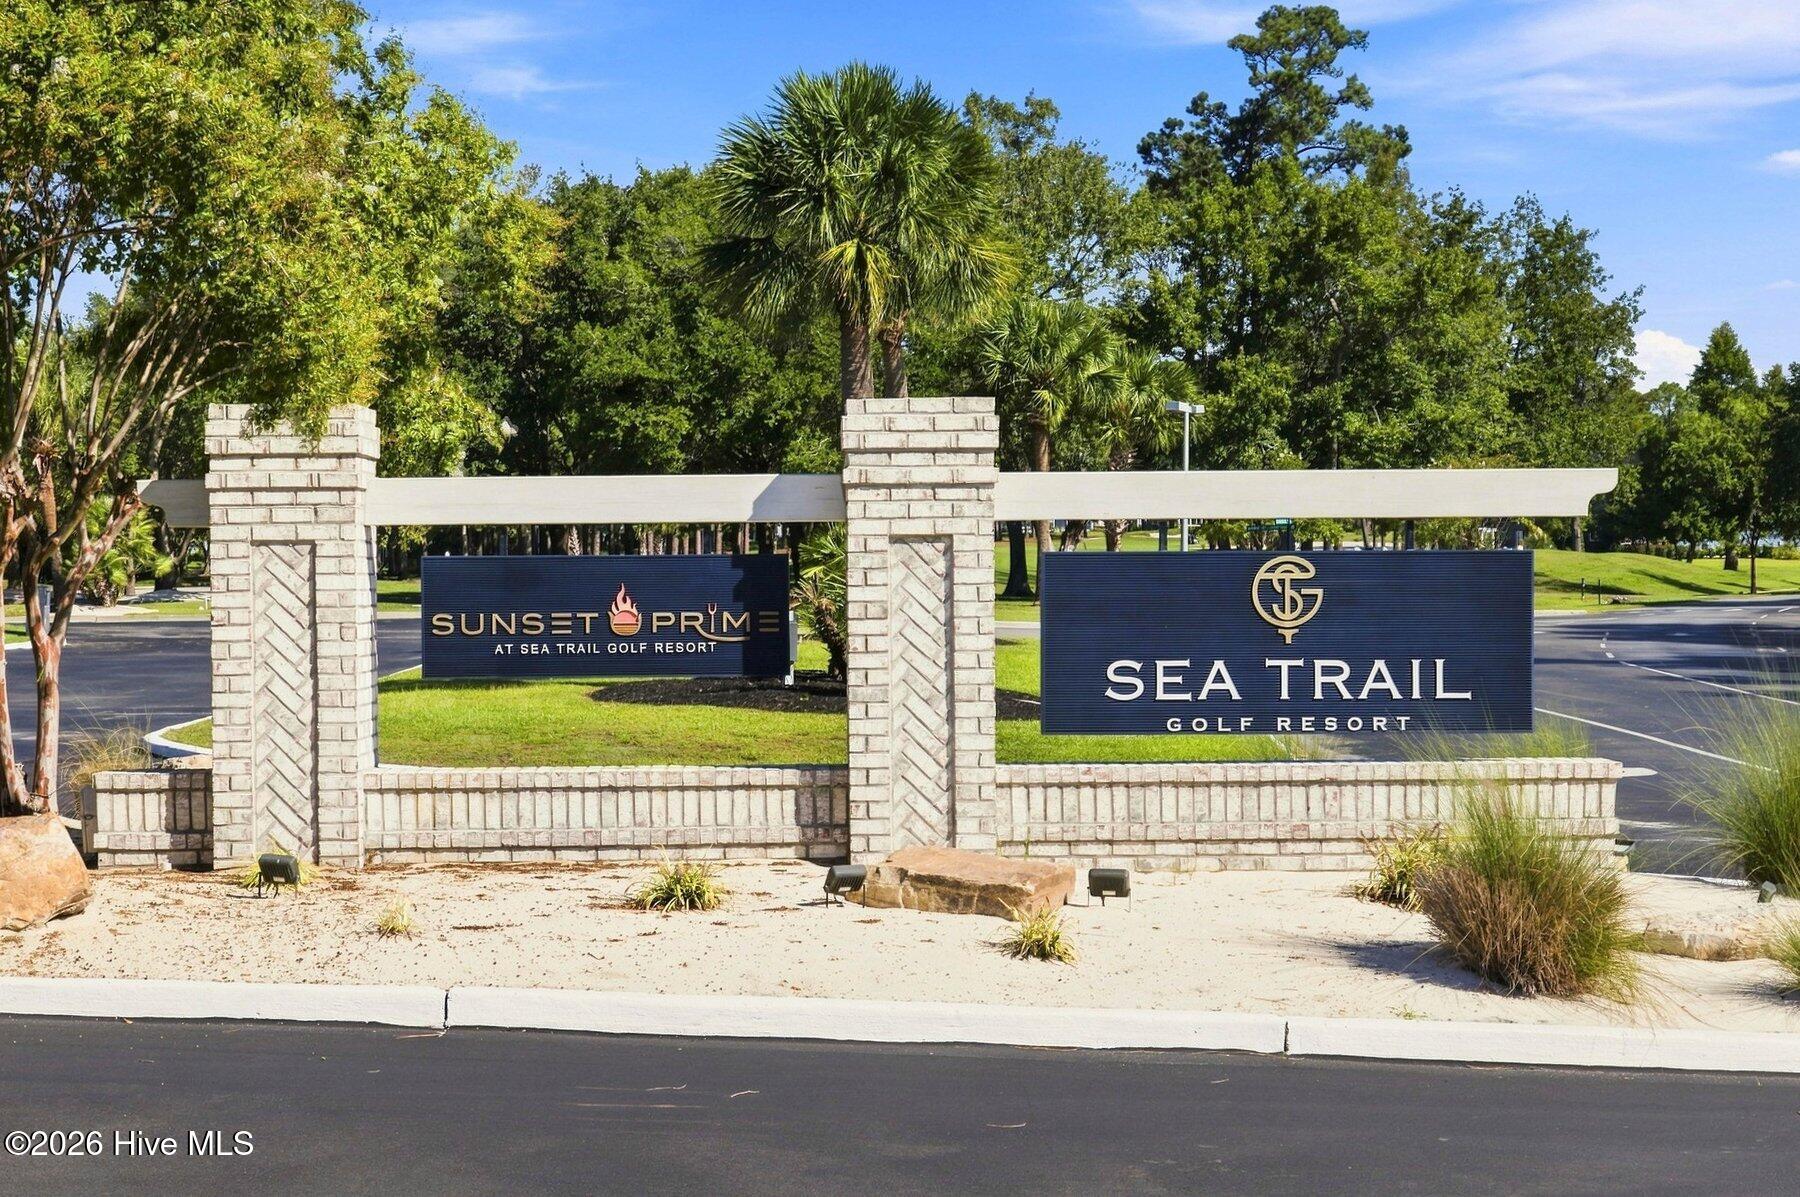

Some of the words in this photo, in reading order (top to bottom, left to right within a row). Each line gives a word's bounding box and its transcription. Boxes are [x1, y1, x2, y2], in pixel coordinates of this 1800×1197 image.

[431, 612, 598, 636] SUNSET
[652, 602, 780, 642] PRIME
[494, 644, 514, 655] AT
[520, 644, 550, 655] SEA
[556, 643, 600, 654] TRAIL
[607, 643, 647, 654] GOLF
[655, 642, 717, 654] RESORT
[1104, 659, 1242, 701] SEA
[1265, 657, 1472, 701] TRAIL
[1166, 717, 1253, 732] GOLF
[1277, 715, 1411, 731] RESORT
